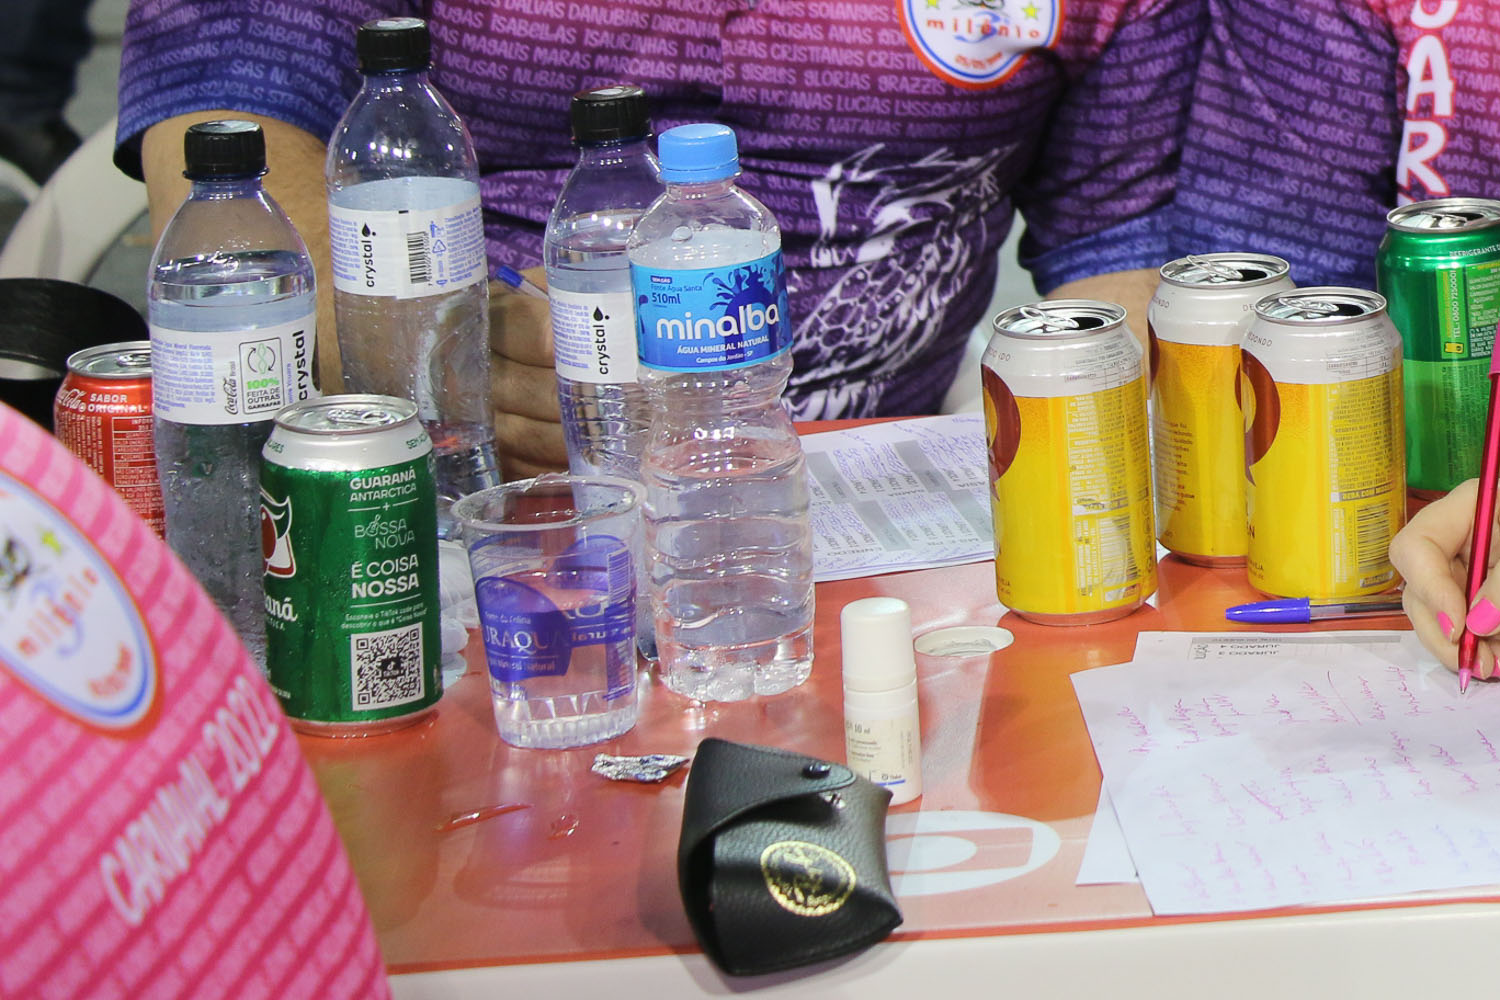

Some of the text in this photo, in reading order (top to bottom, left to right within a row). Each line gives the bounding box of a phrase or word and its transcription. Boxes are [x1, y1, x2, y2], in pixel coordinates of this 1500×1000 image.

[361, 240, 377, 288] crystal
[652, 292, 681, 304] 510ml
[656, 303, 780, 341] minalba
[593, 324, 611, 375] crystal
[677, 335, 769, 354] ÁGUA MINERAL NATURAL
[292, 328, 307, 401] crystal
[247, 377, 280, 390] 100%
[247, 387, 281, 398] FEITA DE
[88, 402, 145, 413] ORIGINAL
[89, 392, 128, 403] SABOR
[247, 393, 281, 404] OUTRAS
[349, 465, 417, 491] GUARANÁ
[349, 484, 417, 503] ANTARCTICA
[354, 514, 407, 538] BOSSA
[375, 530, 416, 550] NOVA
[351, 553, 419, 579] É COISA
[351, 572, 420, 599] NOSSA
